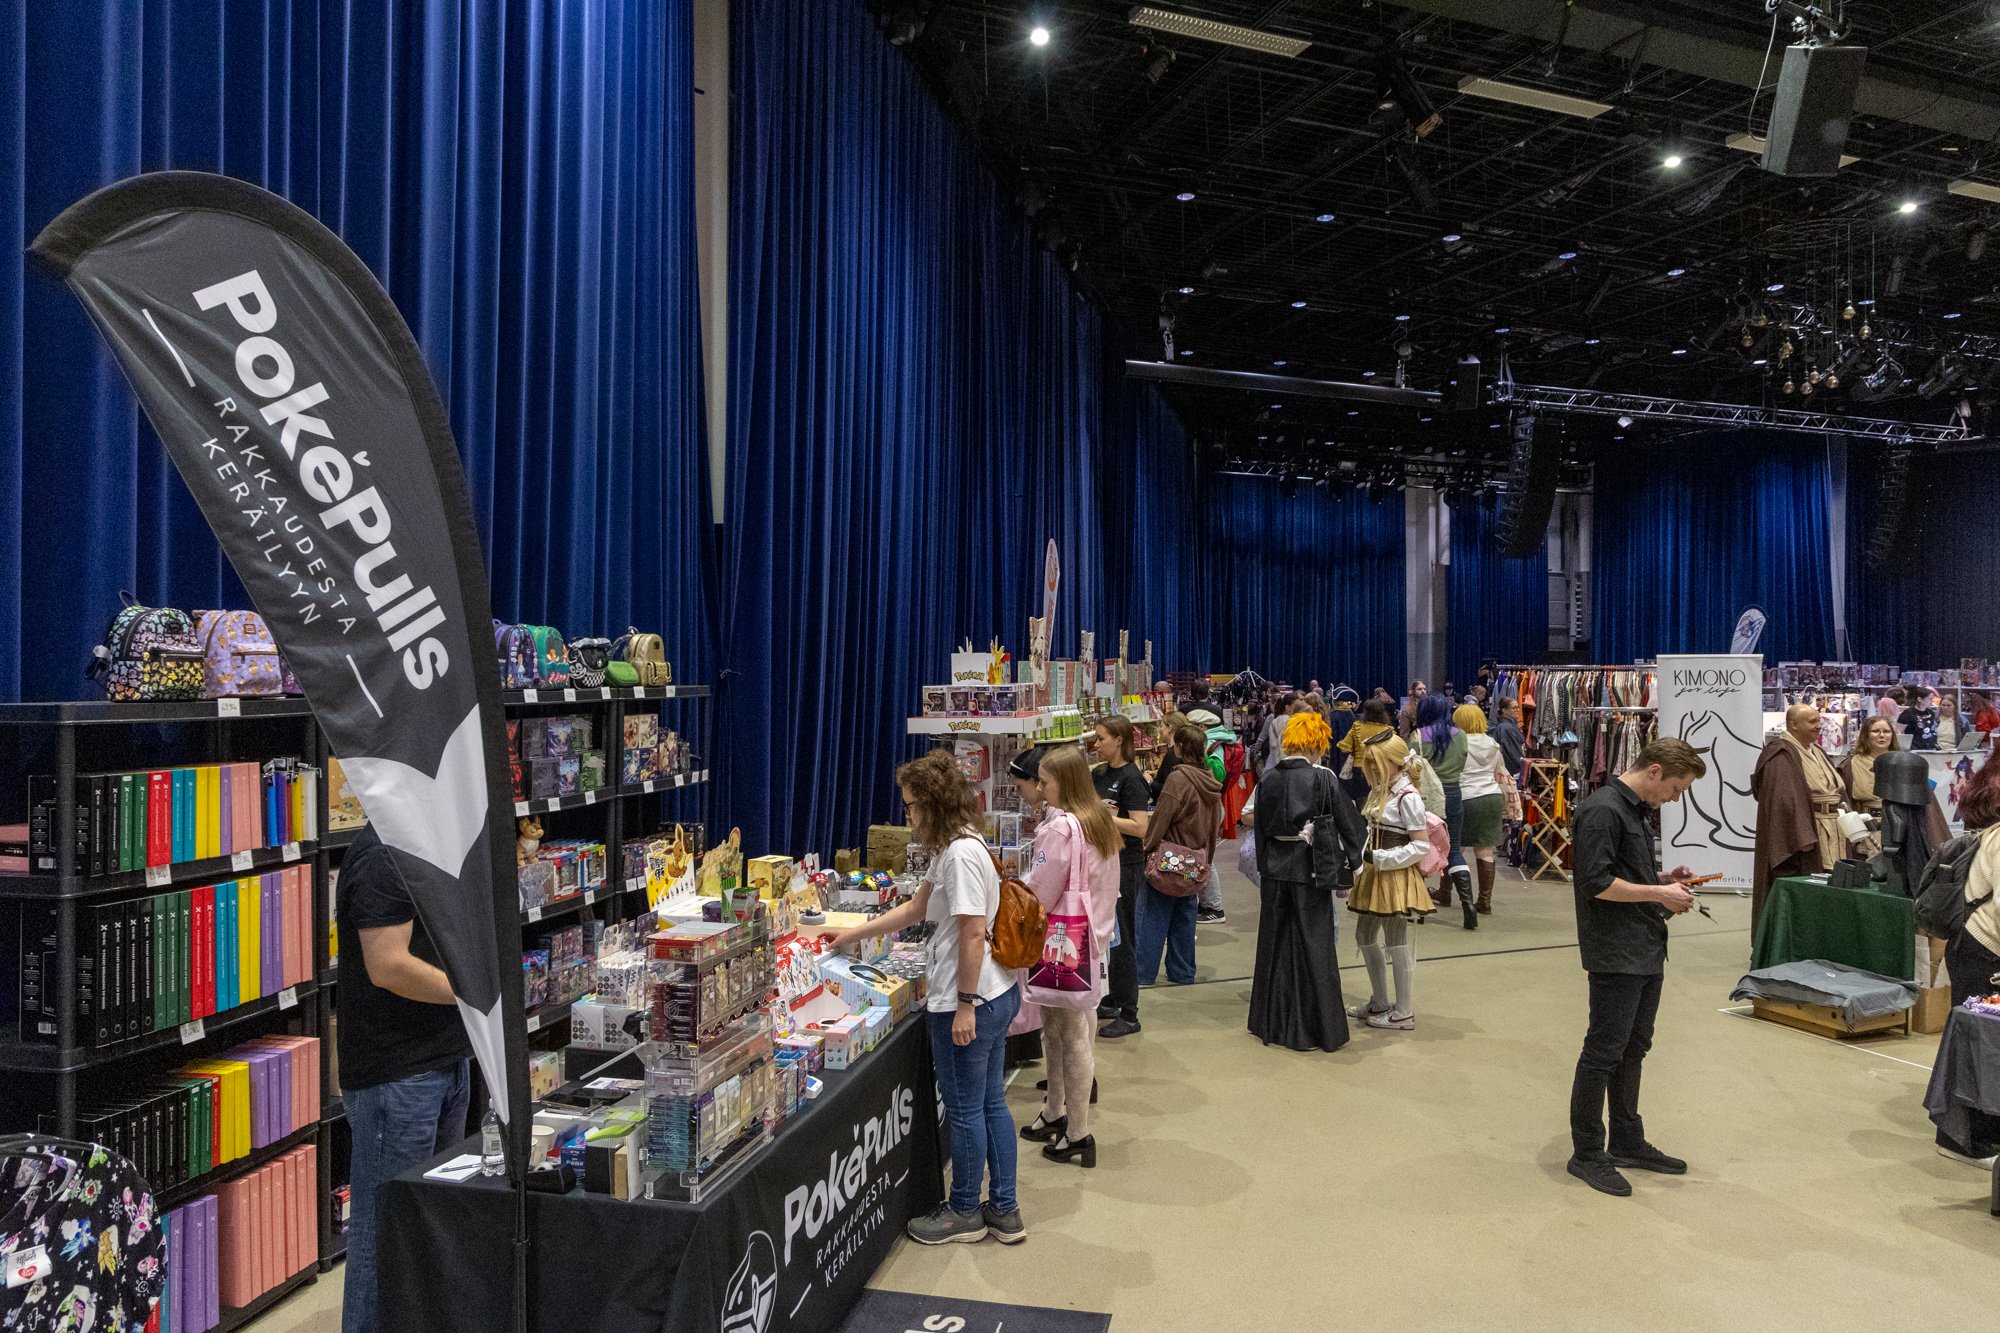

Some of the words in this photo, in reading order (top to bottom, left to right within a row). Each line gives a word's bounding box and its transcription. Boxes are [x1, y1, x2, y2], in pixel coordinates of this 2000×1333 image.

[202, 437, 321, 625] KERÄILYYN
[214, 396, 357, 635] RAKKAUDESTA
[1674, 669, 1746, 686] KIMONO
[1674, 687, 1702, 698] for
[1703, 686, 1741, 698] life
[816, 1171, 891, 1269] RAKKAUDESTA
[824, 1205, 885, 1288] KERÄILYYN
